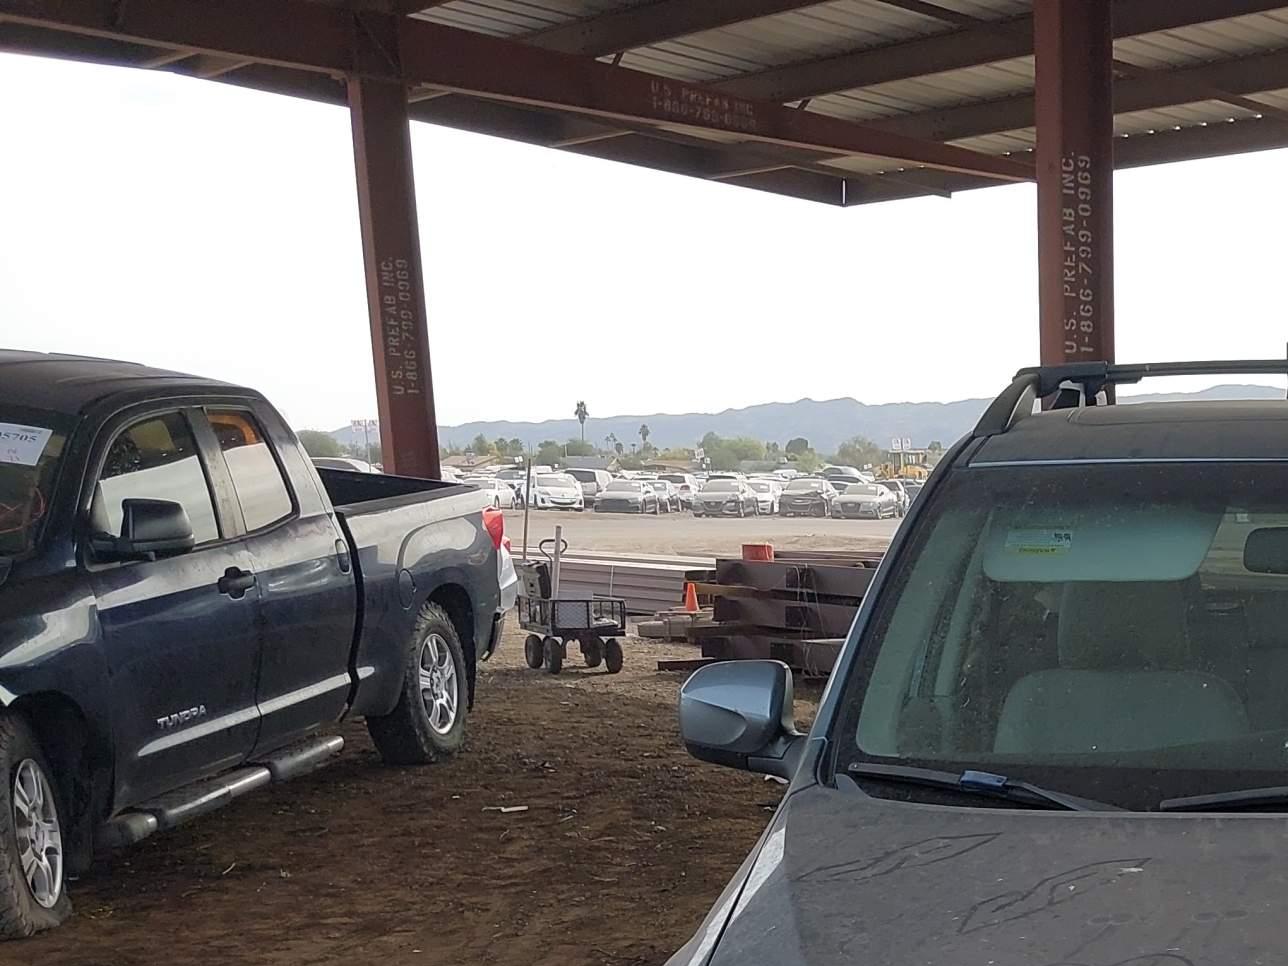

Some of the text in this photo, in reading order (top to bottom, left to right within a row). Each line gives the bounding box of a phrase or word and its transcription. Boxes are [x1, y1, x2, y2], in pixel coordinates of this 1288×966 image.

[381, 256, 396, 287] INC.
[1062, 152, 1077, 353] U.S. PREFAB INC.
[1078, 155, 1094, 352] 1-866-799-0969
[384, 295, 401, 356] PREFAB
[157, 704, 207, 729] TUNDRA
